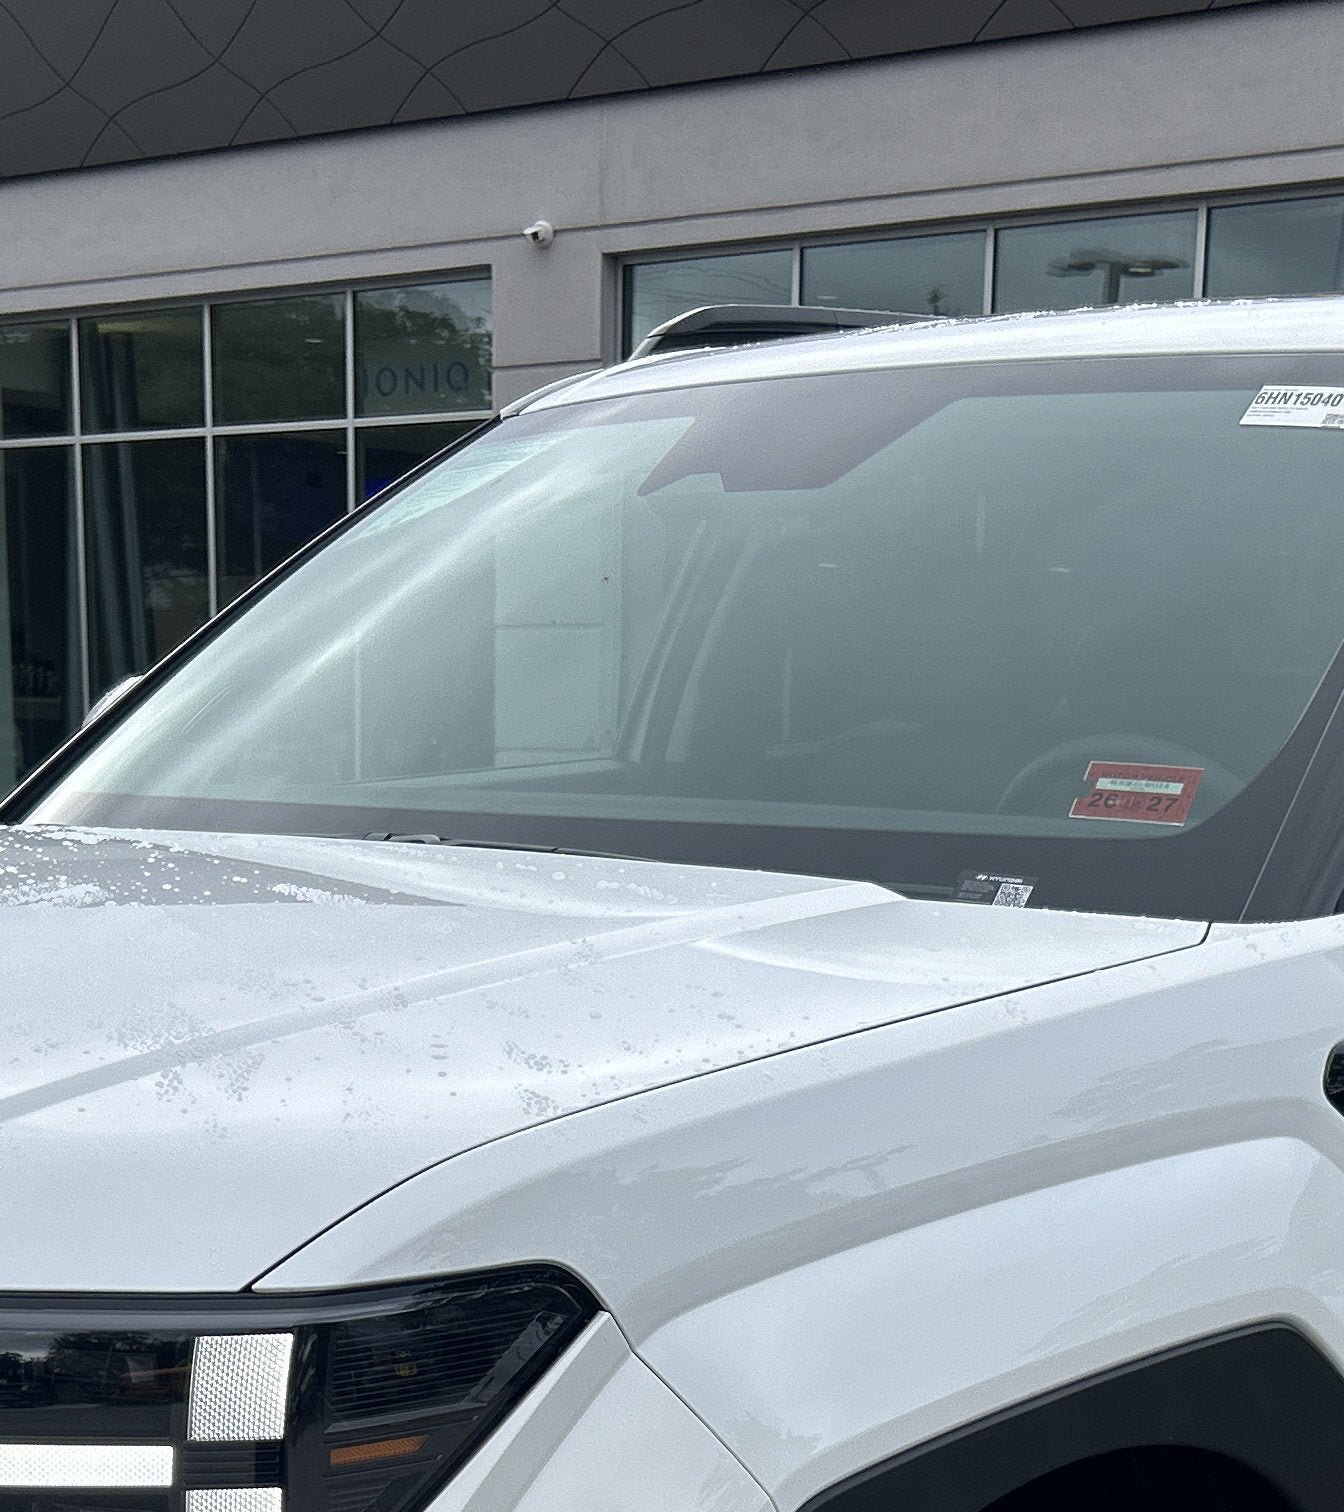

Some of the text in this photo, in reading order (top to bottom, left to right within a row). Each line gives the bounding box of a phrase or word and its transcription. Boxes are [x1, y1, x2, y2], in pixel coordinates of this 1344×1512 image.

[360, 361, 470, 400] IONIQ
[1254, 391, 1344, 407] 6HN15040
[1145, 796, 1179, 813] 27
